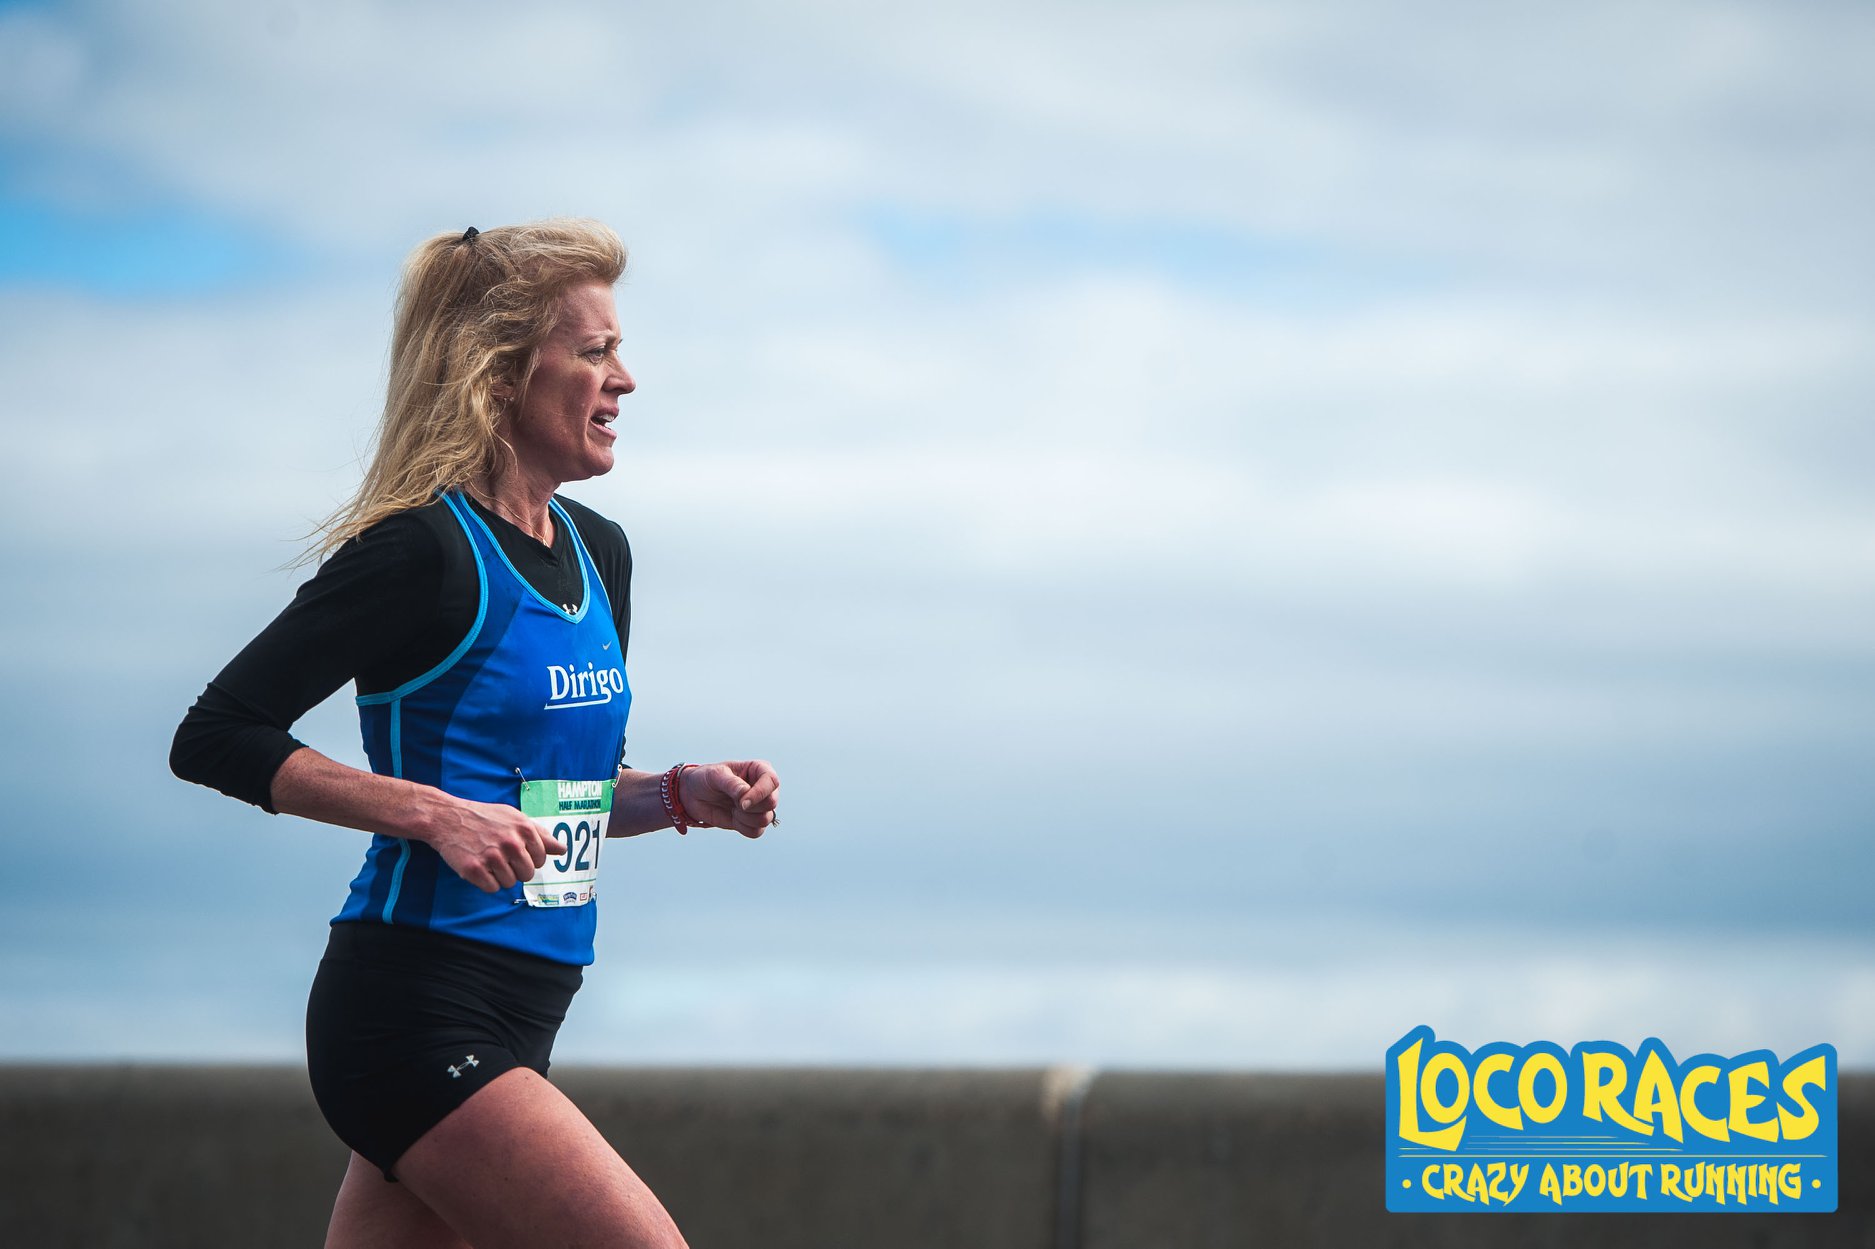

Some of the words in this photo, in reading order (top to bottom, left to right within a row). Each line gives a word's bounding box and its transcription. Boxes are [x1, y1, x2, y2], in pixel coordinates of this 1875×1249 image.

[545, 662, 624, 708] Dirigo
[557, 781, 603, 798] HAMPTON
[558, 801, 573, 811] HALF
[552, 820, 601, 873] 921
